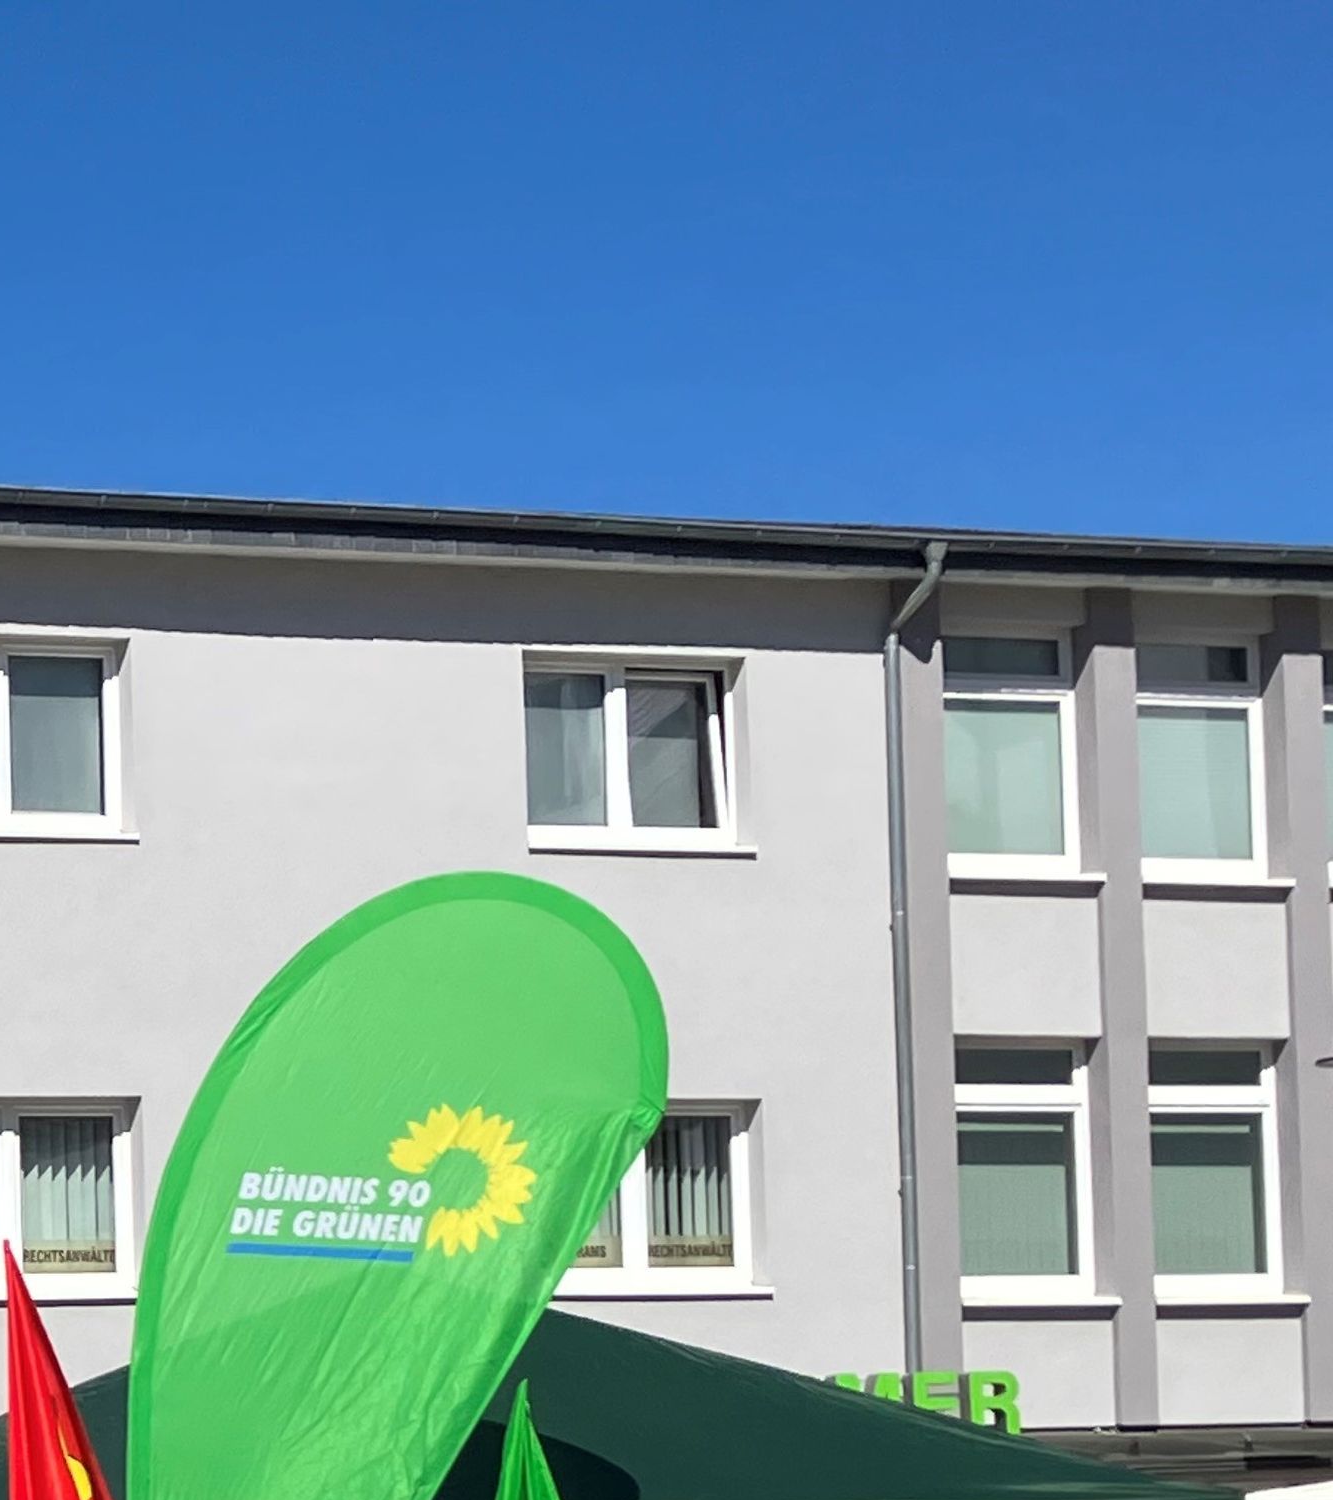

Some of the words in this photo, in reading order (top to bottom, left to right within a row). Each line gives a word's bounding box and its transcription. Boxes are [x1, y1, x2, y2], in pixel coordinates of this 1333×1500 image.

[238, 1166, 380, 1205] BÜNDNIS
[388, 1179, 431, 1207] 90
[230, 1207, 284, 1236] DIE
[292, 1205, 423, 1243] GRÜNEN
